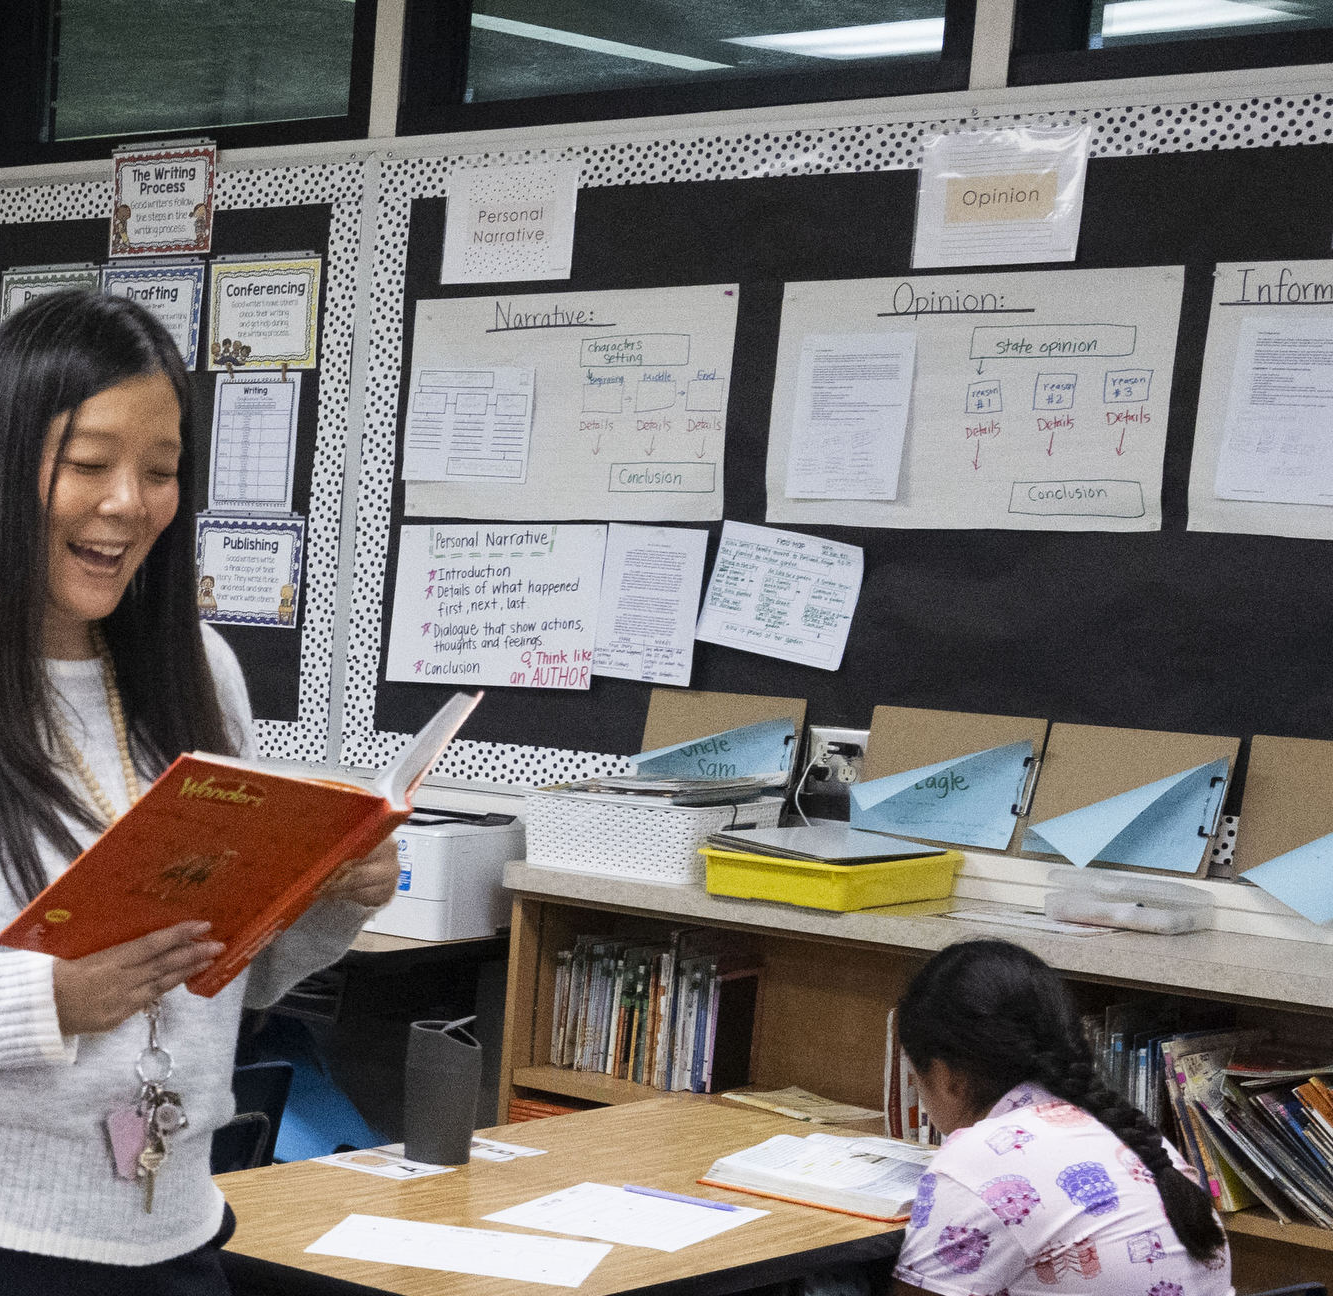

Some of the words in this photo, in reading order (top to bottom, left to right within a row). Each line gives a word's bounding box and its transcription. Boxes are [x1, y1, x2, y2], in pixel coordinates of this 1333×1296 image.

[132, 169, 150, 182] The
[154, 166, 196, 180] Writing
[140, 182, 186, 195] Process
[962, 187, 1039, 208] Opinion
[478, 207, 544, 223] Personal
[473, 227, 545, 244] Narrative
[126, 286, 178, 302] Drafting
[226, 281, 306, 297] Conferencing
[893, 282, 1004, 321] Opinion:
[495, 301, 595, 330] Narrative:
[587, 339, 643, 353] characters
[996, 338, 1033, 354] state
[1039, 338, 1098, 357] opinion
[603, 353, 643, 366] setting
[697, 368, 717, 381] End
[1111, 376, 1146, 387] reason
[244, 386, 268, 395] Writing
[971, 387, 999, 398] reason
[1043, 382, 1076, 392] reason
[579, 418, 614, 432] Details
[636, 417, 671, 432] Details
[686, 417, 722, 432] Details
[966, 420, 1001, 439] Details
[1037, 415, 1075, 432] Details
[1106, 405, 1151, 426] Details
[618, 467, 682, 486] Conclusion
[1028, 484, 1108, 502] Conclusion
[223, 536, 279, 554] Publishing
[435, 531, 479, 550] Personal
[486, 531, 549, 547] Narrative
[437, 564, 511, 581] Introduction
[437, 583, 470, 598] Details
[474, 581, 488, 594] of
[492, 578, 523, 594] what
[527, 578, 580, 594] happened
[434, 622, 479, 642] Dialogue
[483, 622, 507, 636] that
[510, 620, 536, 633] show
[540, 617, 584, 632] actions,
[433, 638, 477, 655] thoughts
[481, 633, 500, 648] and
[535, 650, 568, 665] Think
[573, 649, 593, 663] like
[424, 660, 480, 676] Conclusion
[509, 670, 526, 685] an
[530, 665, 589, 688] AUTHOR
[697, 758, 737, 778] Sam
